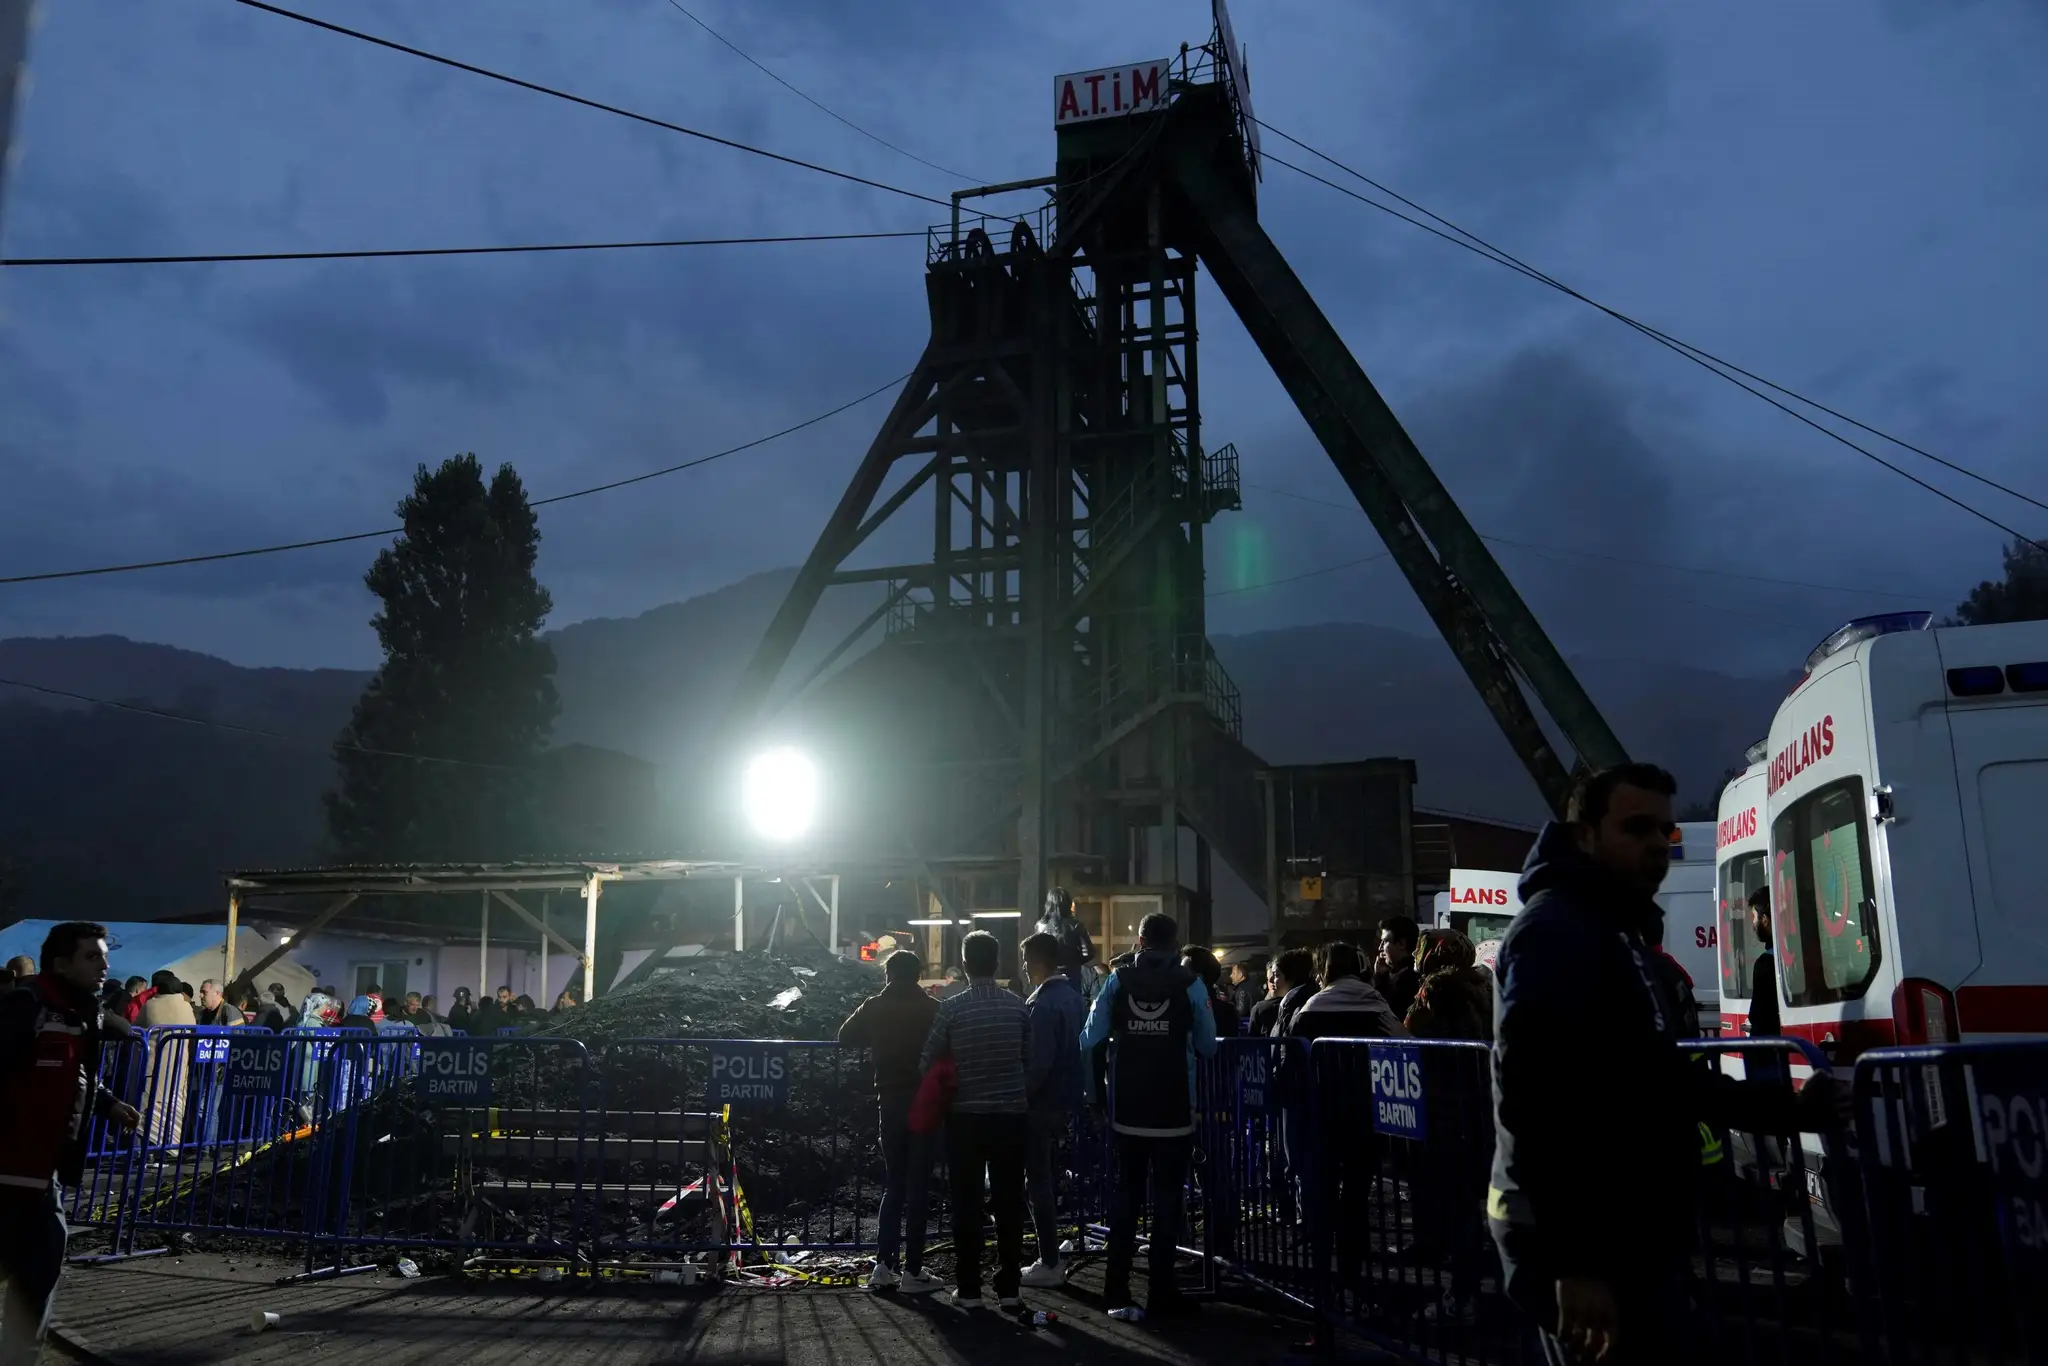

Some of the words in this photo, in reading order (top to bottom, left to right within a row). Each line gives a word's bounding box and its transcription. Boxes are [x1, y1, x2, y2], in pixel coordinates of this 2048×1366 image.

[1450, 887, 1508, 906] LANS
[1127, 1020, 1170, 1031] UMKE
[228, 1042, 282, 1072] POLİS
[422, 1047, 488, 1076] POLİS
[712, 1051, 785, 1080] POLİS
[1239, 1048, 1267, 1084] POLİS
[232, 1074, 272, 1090] BARTIN
[429, 1079, 478, 1095] BARTIN
[720, 1083, 775, 1099] BARTIN
[1370, 1053, 1423, 1100] POLİS
[1378, 1100, 1417, 1129] BARTIN
